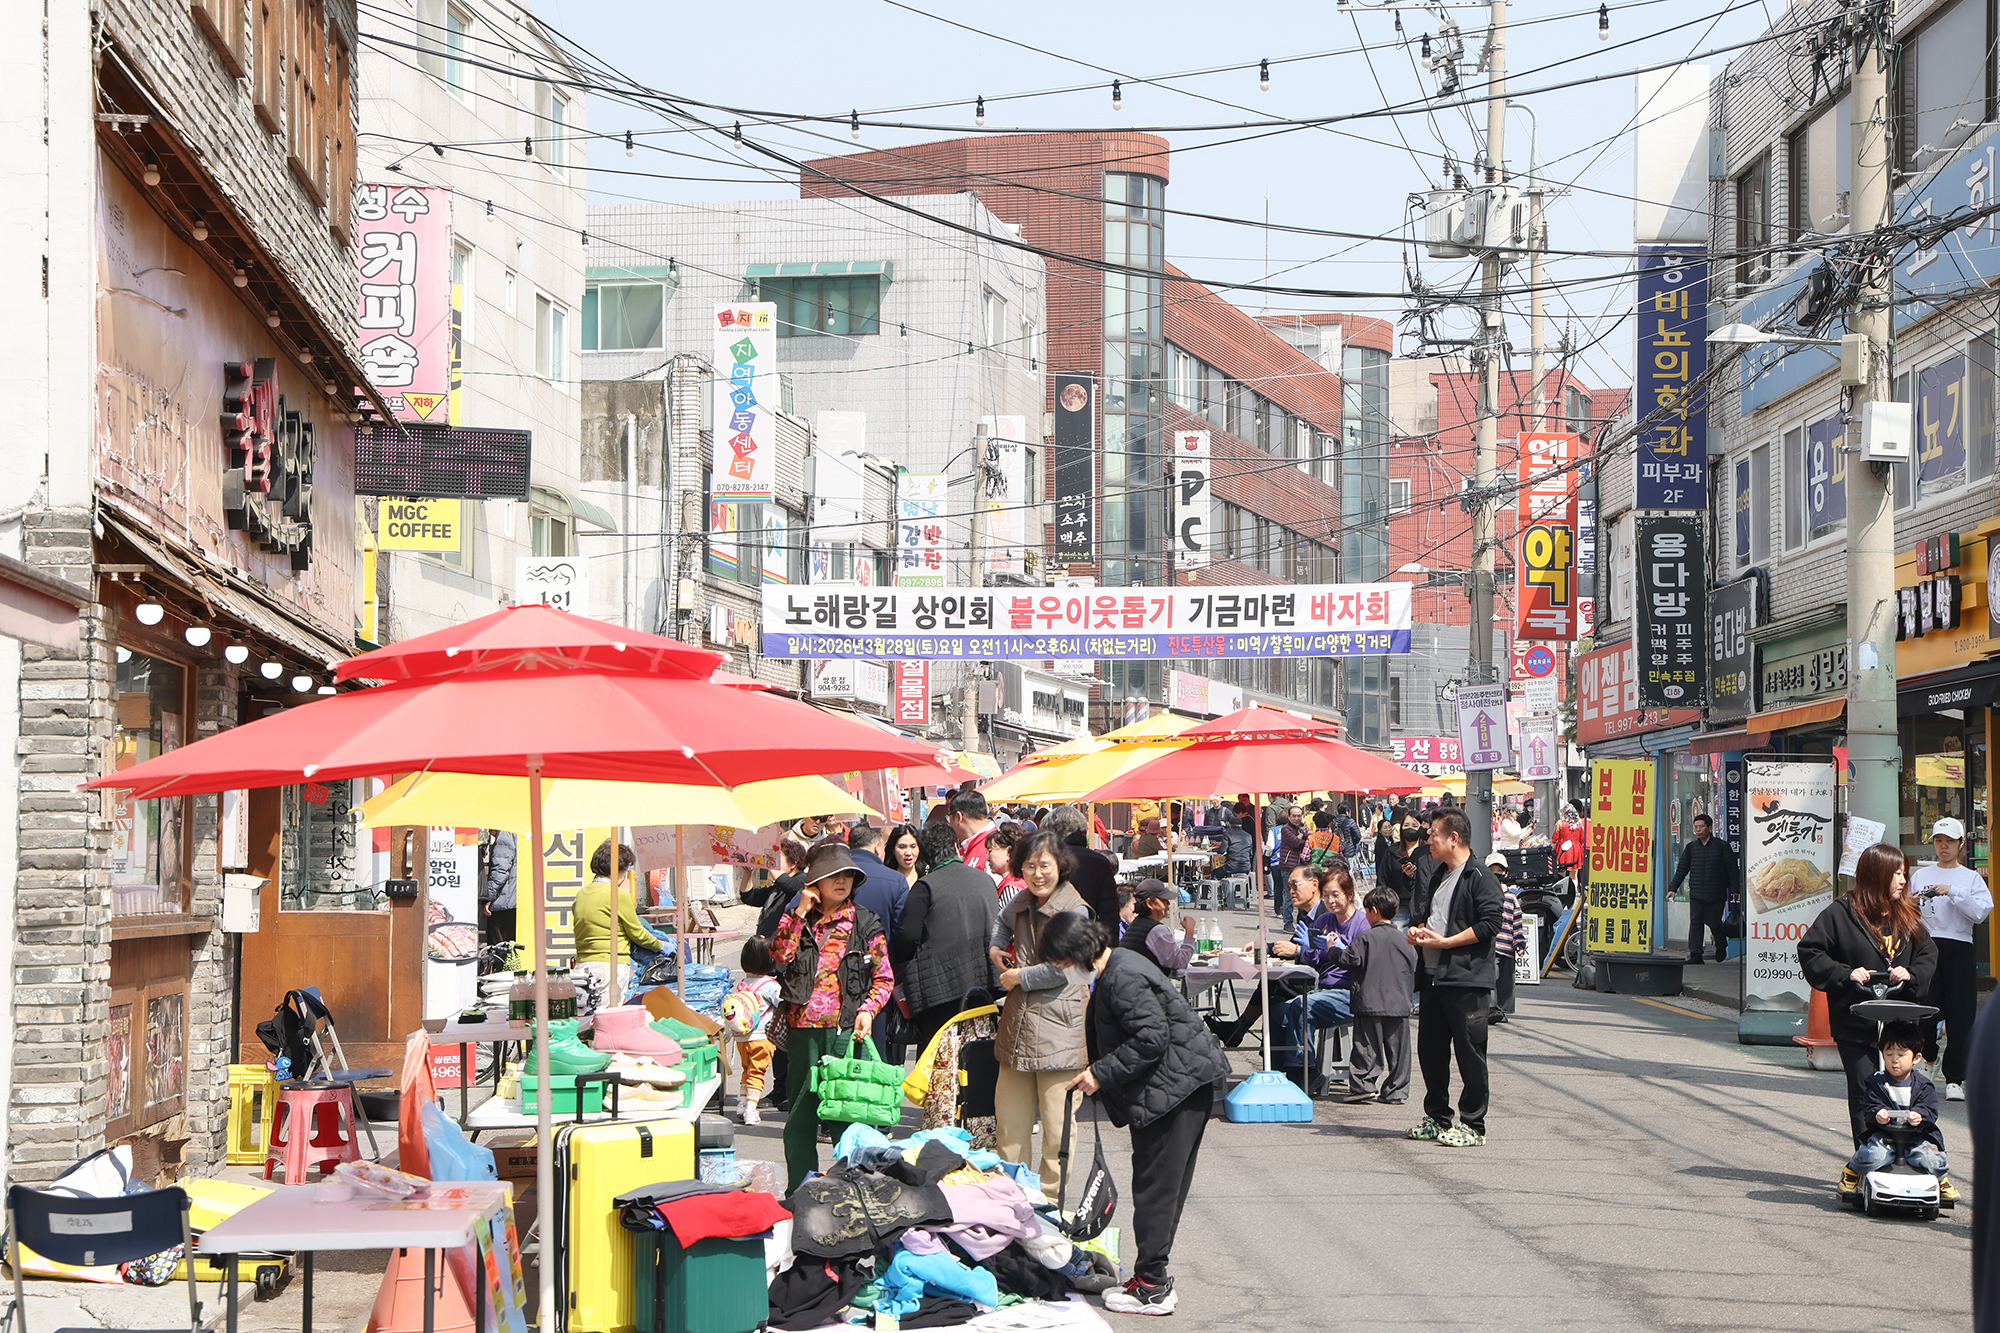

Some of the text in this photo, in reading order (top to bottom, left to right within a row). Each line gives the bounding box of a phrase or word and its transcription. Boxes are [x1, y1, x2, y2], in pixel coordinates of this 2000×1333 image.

[358, 185, 430, 223] 성수
[360, 231, 419, 387] 커피숍
[720, 311, 769, 326] 무지개
[1653, 290, 1694, 457] 비뇨의학과
[413, 397, 434, 409] 지하
[733, 343, 754, 474] 지역아동센터
[1642, 463, 1702, 484] 피부과
[1810, 441, 1828, 512] 용
[716, 483, 769, 491] 070-8278-2147
[1663, 489, 1684, 503] 2F
[388, 504, 428, 520] MGC
[1060, 512, 1088, 527] 소주
[388, 522, 451, 538] COFFEE
[1060, 531, 1087, 546] 맥주
[1187, 558, 1198, 567] 2F
[900, 578, 943, 588] 997-7896
[1524, 526, 1573, 635] 약국
[1652, 533, 1690, 617] 용다방
[785, 590, 1390, 629] 노해랑길 상인회 불우이웃돕기 기금마련 바자회
[1651, 623, 1692, 636] 커피
[1714, 606, 1746, 661] 용다방
[786, 636, 963, 656] 일시:2026년3월28일(토)요일
[968, 636, 1081, 656] 오전11시~오후6시
[1084, 636, 1157, 656] (차없는거리)
[1237, 633, 1351, 653] 미역/찰흑미/다양한
[1354, 632, 1391, 652] 먹거리
[1651, 638, 1692, 650] 맥주
[1651, 653, 1692, 666] 양주
[1649, 670, 1695, 683] 민속주점
[818, 684, 850, 692] 904-9282
[1474, 752, 1498, 763] 직진
[1598, 768, 1646, 815] 보쌈
[1592, 823, 1649, 873] 홍어삼합
[429, 860, 456, 873] 할인
[1590, 881, 1649, 909] 해장장칼국수
[1588, 916, 1648, 944] 해물파전
[434, 1055, 461, 1065] 쌍문점
[1076, 1169, 1106, 1221] Supreme
